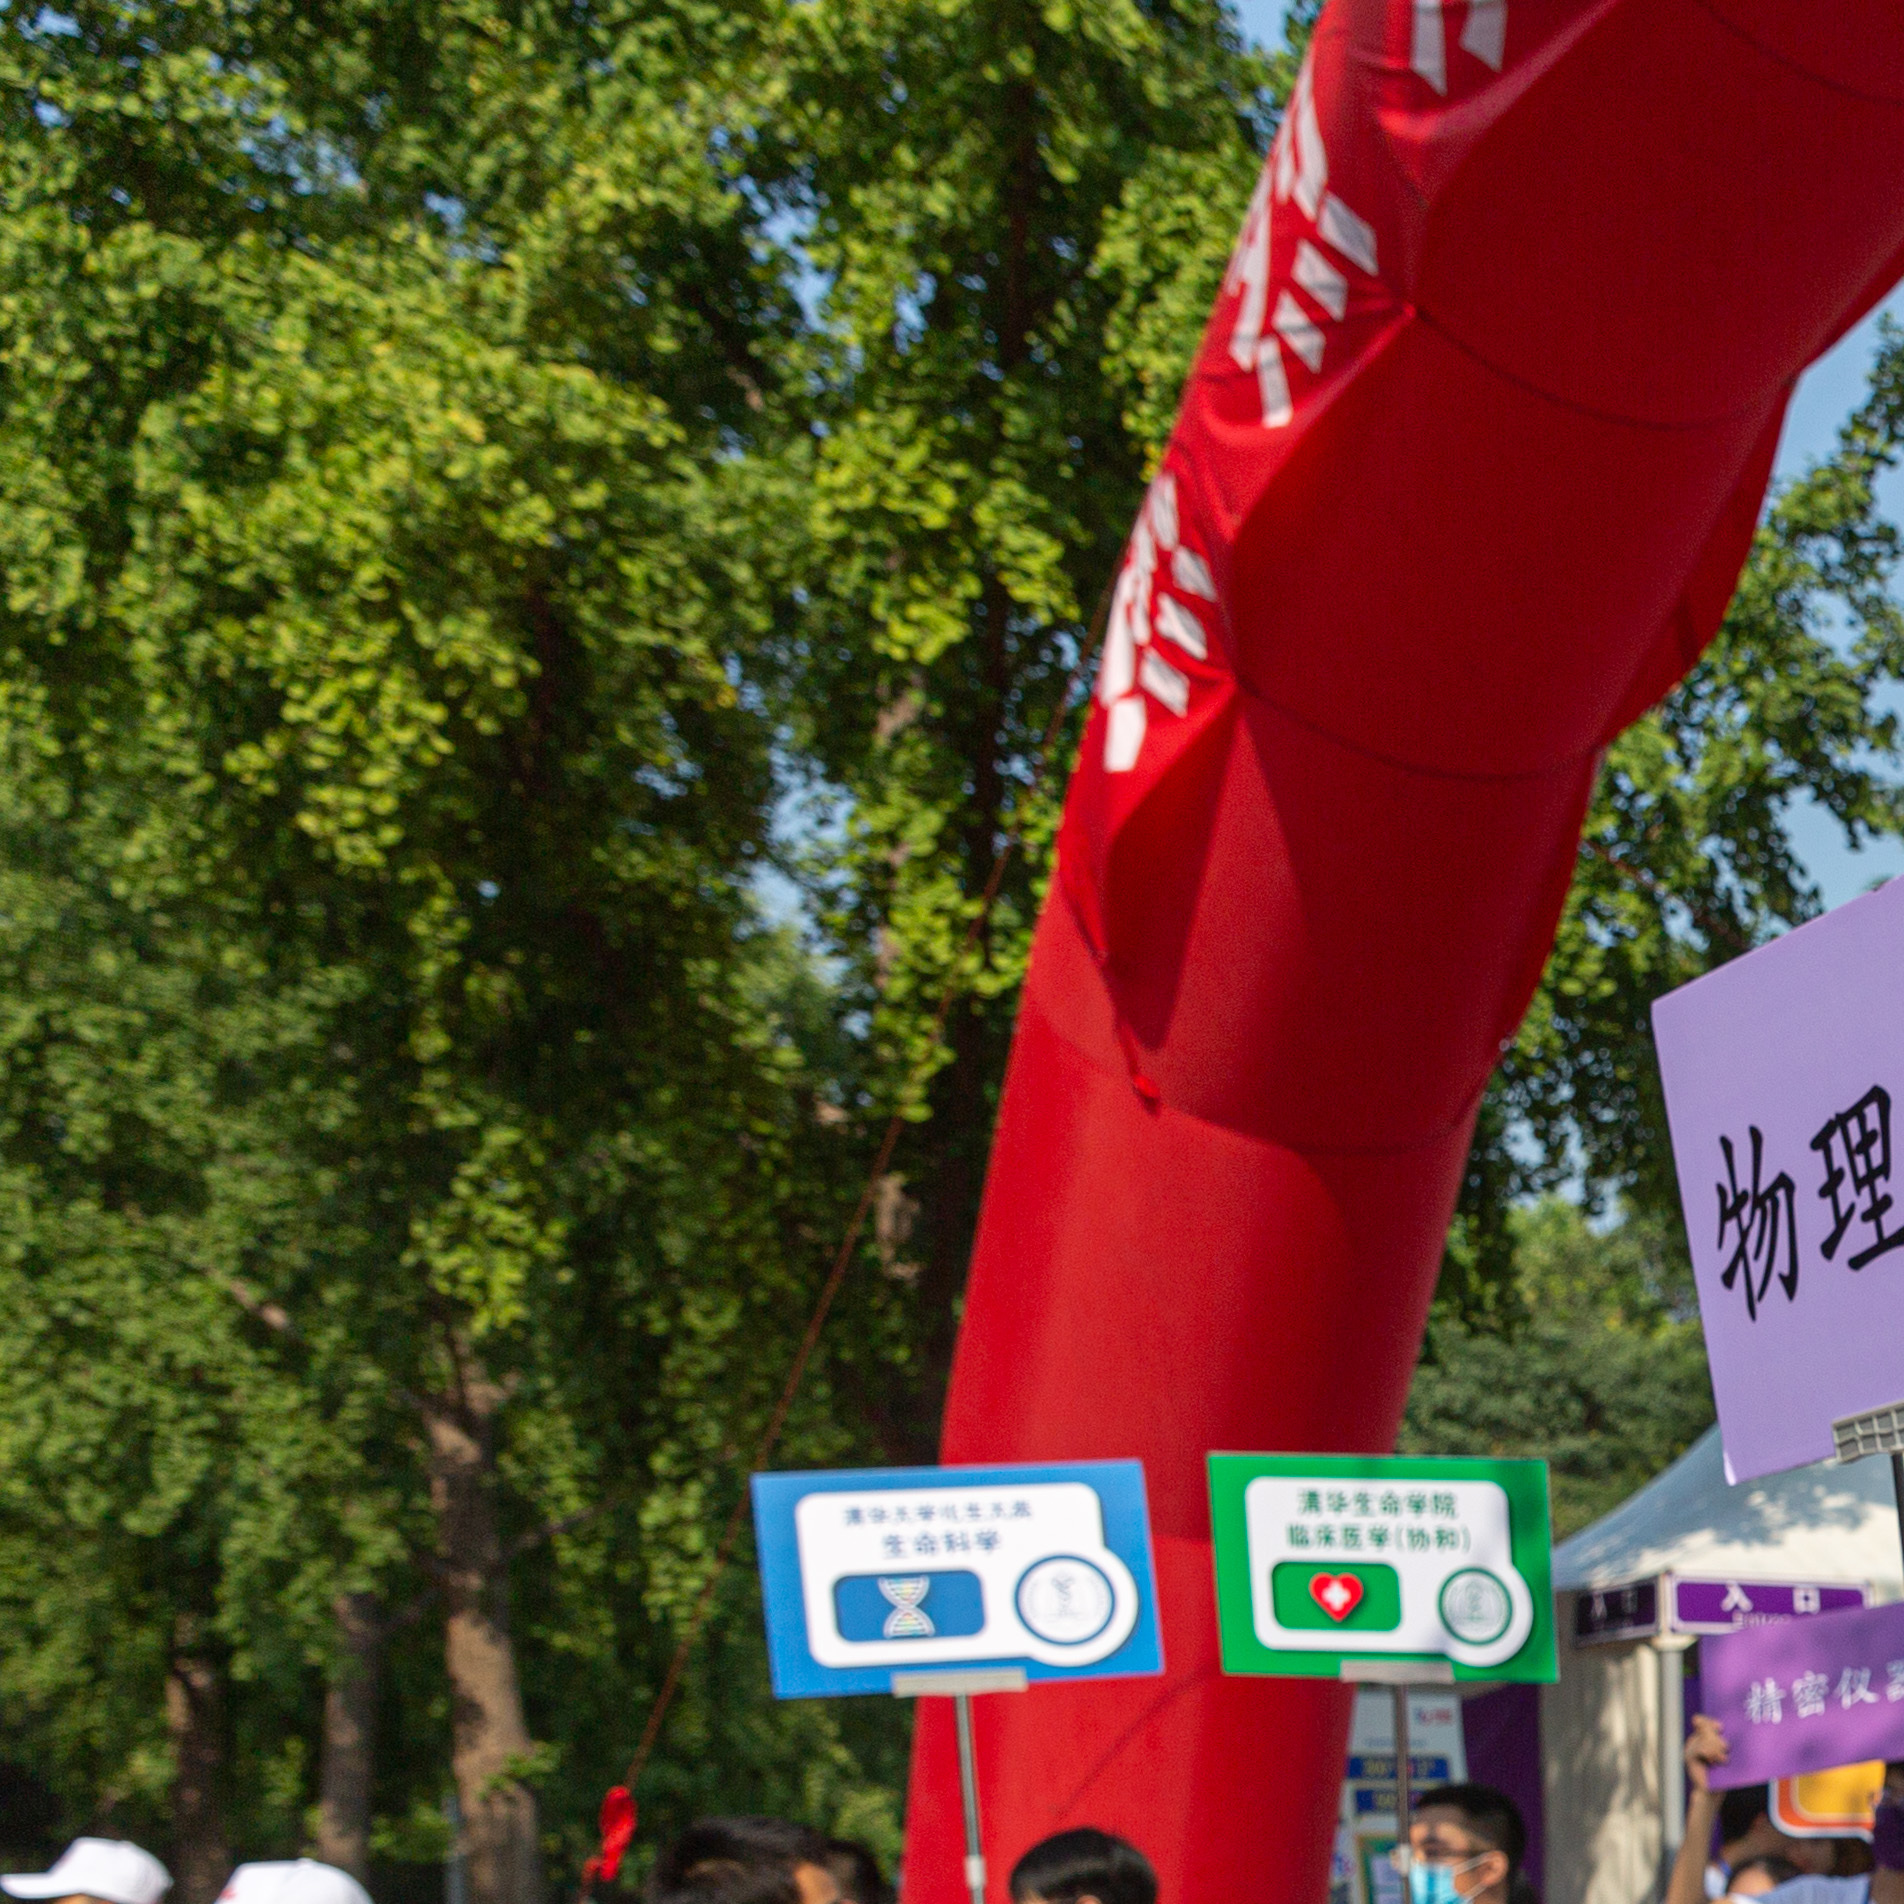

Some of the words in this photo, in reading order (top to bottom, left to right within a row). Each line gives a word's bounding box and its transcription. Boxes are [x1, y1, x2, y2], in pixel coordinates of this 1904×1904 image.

[1298, 1488, 1461, 1518] 清华生命学院
[881, 1529, 1001, 1559] 生命科学
